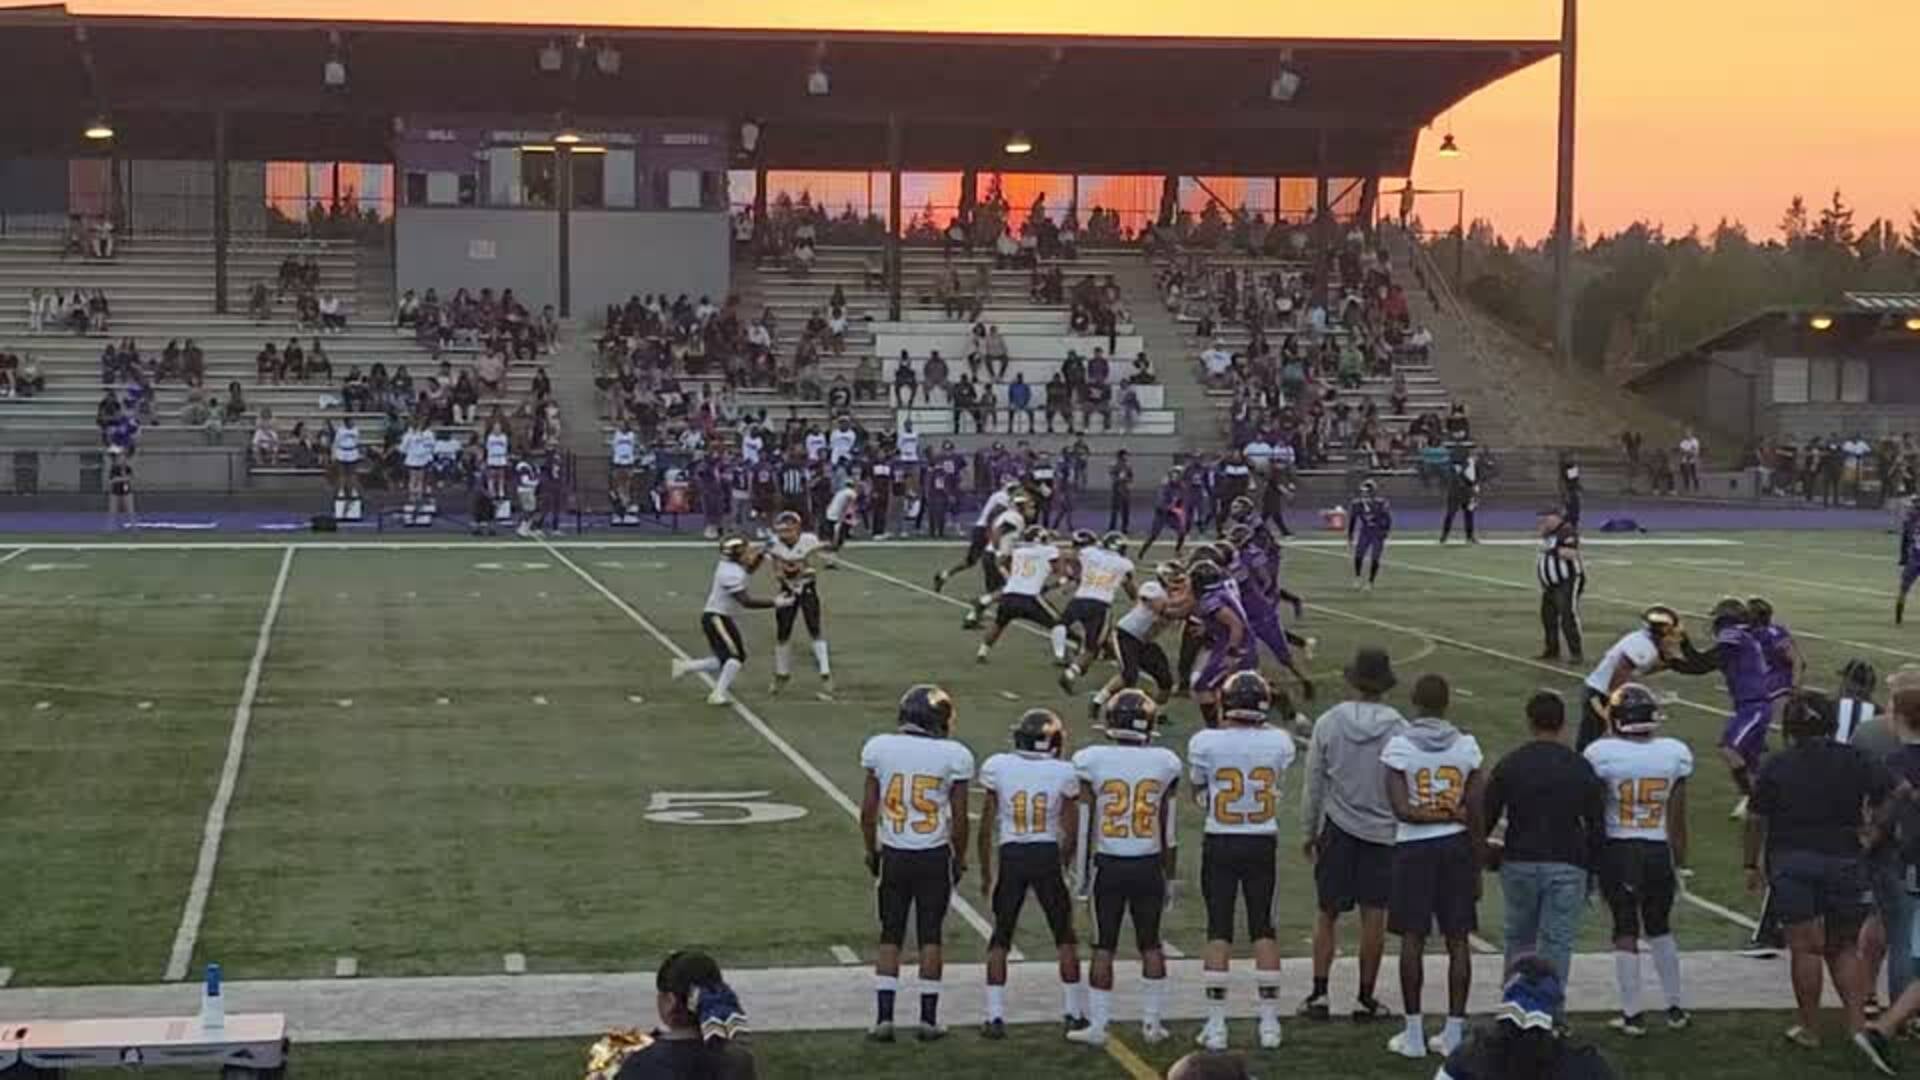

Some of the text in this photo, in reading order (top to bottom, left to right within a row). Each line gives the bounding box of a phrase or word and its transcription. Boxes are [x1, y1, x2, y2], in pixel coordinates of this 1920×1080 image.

[643, 791, 808, 824] 5
[884, 772, 944, 834] 45
[1011, 790, 1048, 834] 11
[1101, 778, 1163, 838] 26
[1215, 767, 1276, 825] 23
[1618, 777, 1668, 829] 15
